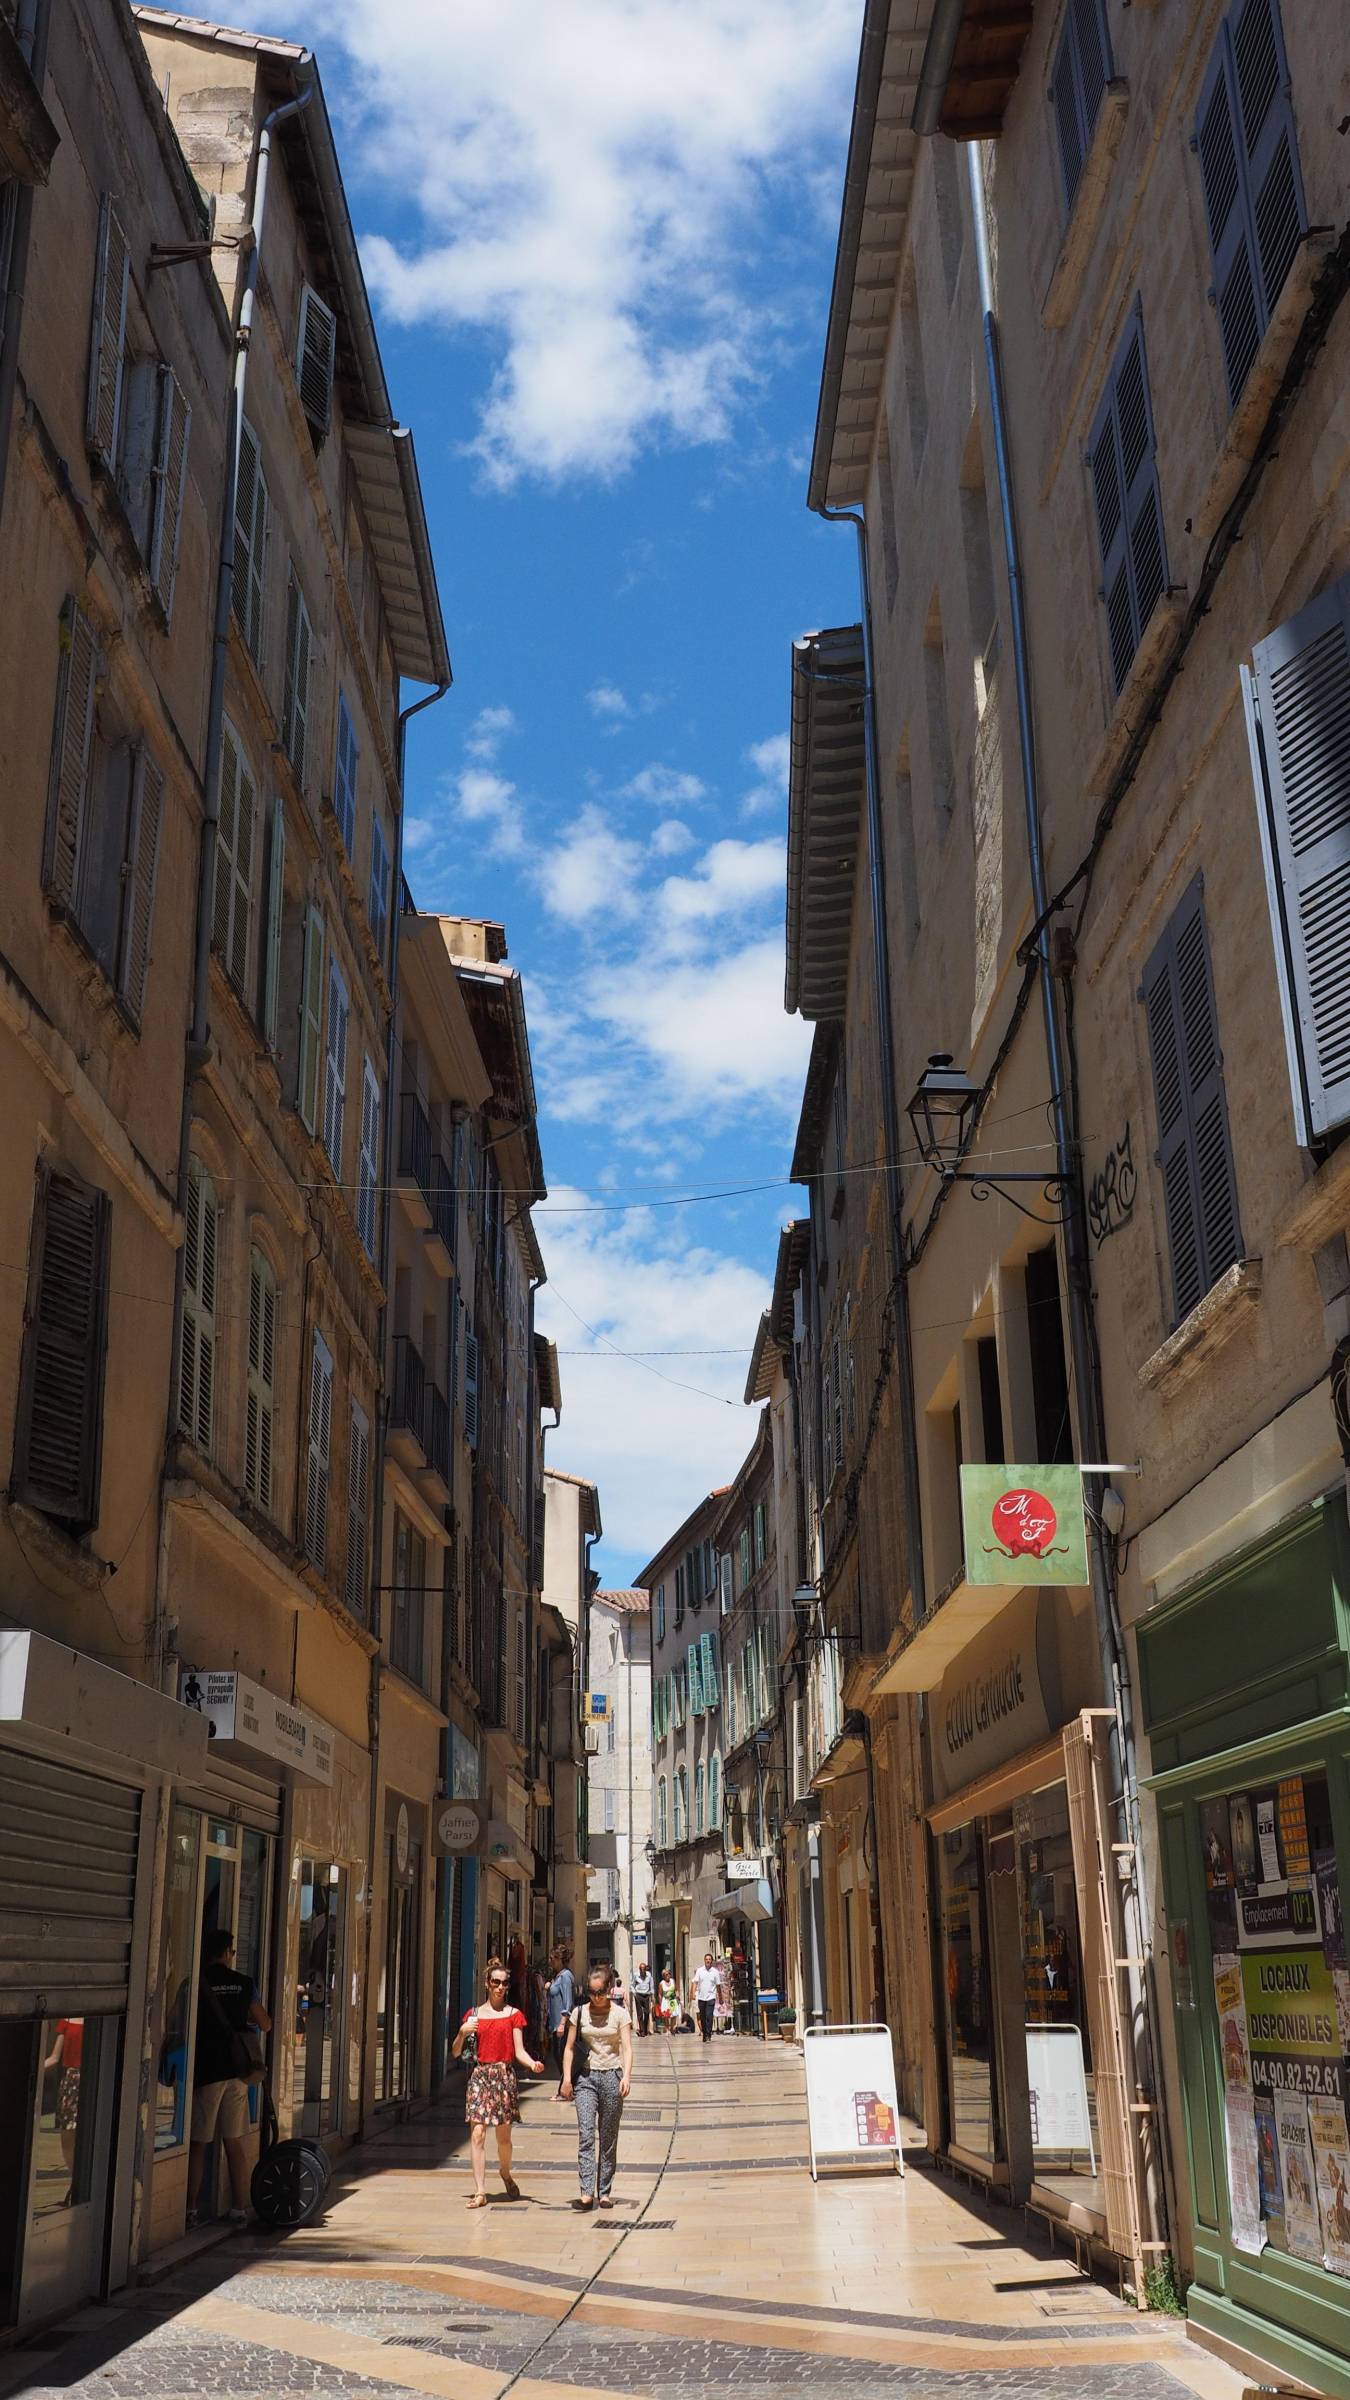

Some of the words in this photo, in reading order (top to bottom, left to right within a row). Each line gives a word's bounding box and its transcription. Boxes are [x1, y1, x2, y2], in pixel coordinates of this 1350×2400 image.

[998, 1494, 1033, 1515] M
[206, 1695, 230, 1704] SEGWAY
[1244, 1904, 1289, 1928] Emplacement
[1259, 1964, 1311, 1993] LOCAUX
[1250, 2013, 1333, 2044] DISPONIBLES
[1252, 2059, 1341, 2095] 04.90.82.52.61
